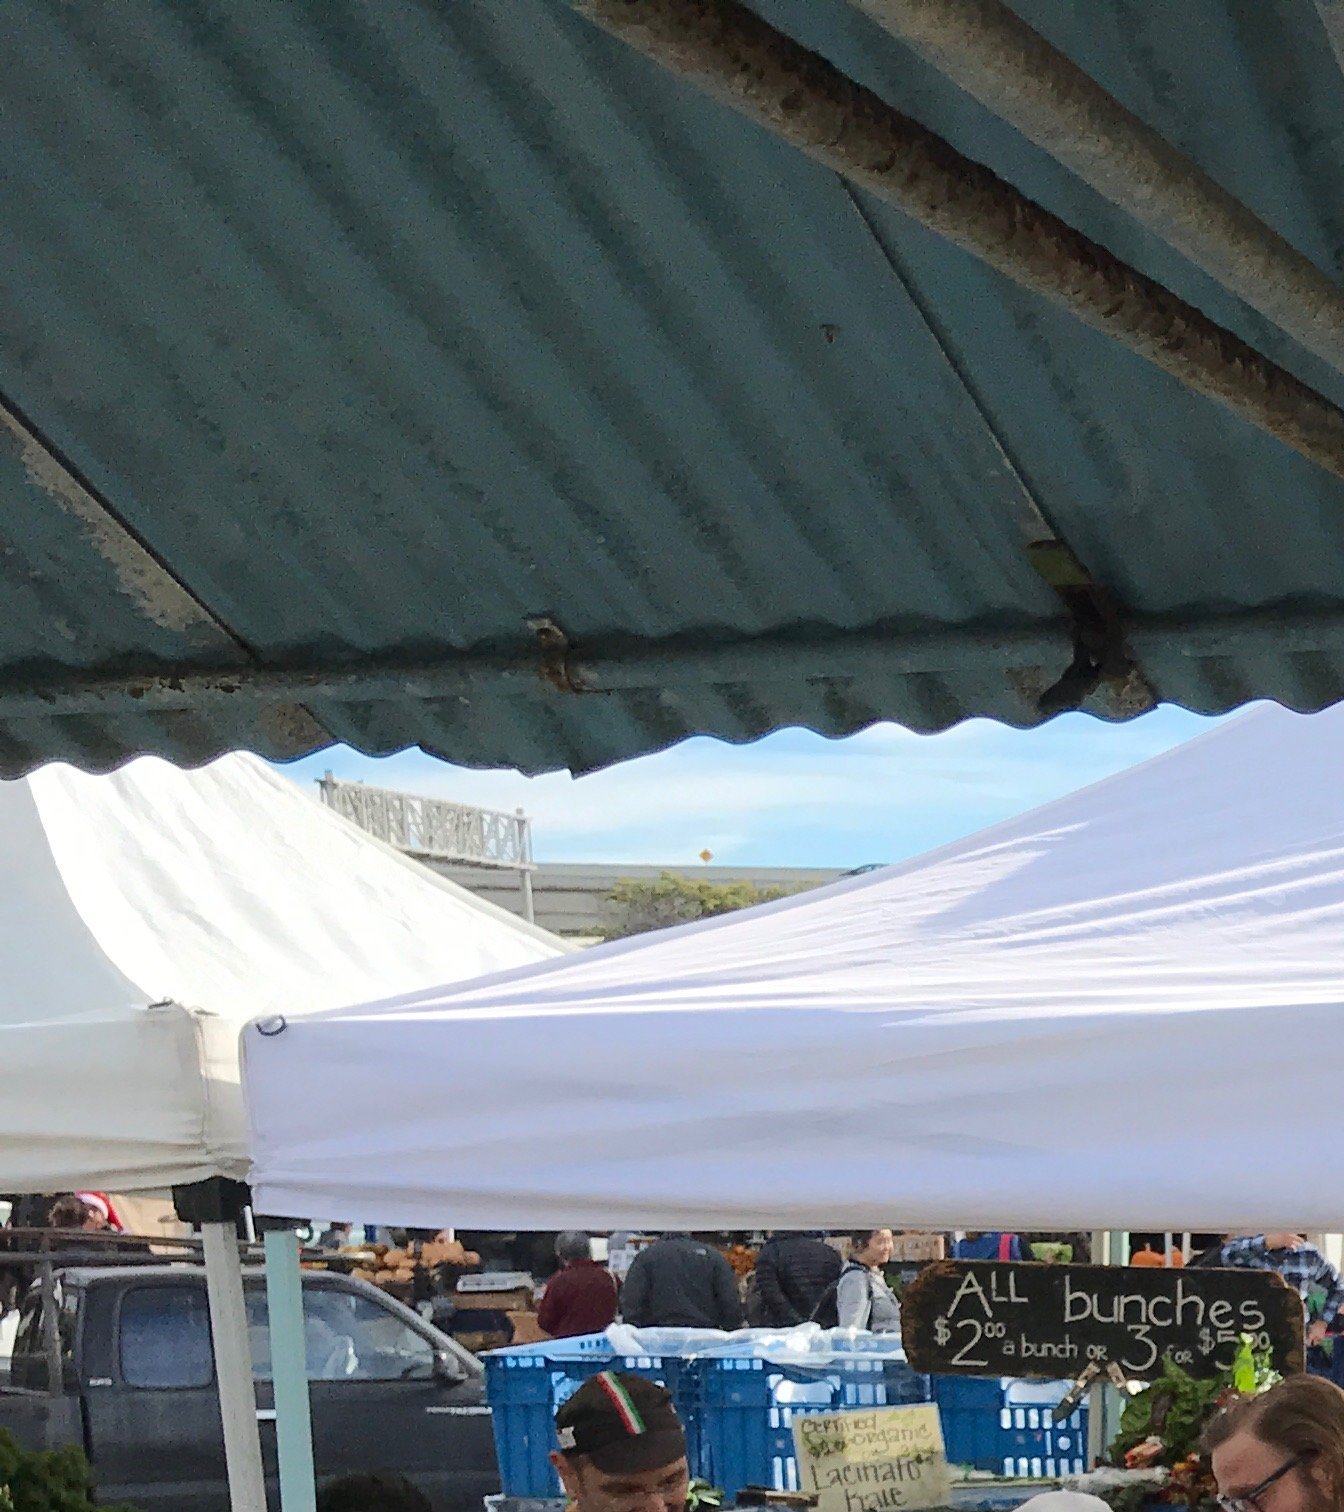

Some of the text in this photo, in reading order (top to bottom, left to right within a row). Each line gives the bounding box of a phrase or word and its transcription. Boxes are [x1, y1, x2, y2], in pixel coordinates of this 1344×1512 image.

[1063, 1275, 1266, 1329] bunches
[1021, 1333, 1078, 1359] bunch
[1122, 1324, 1158, 1372] 3
